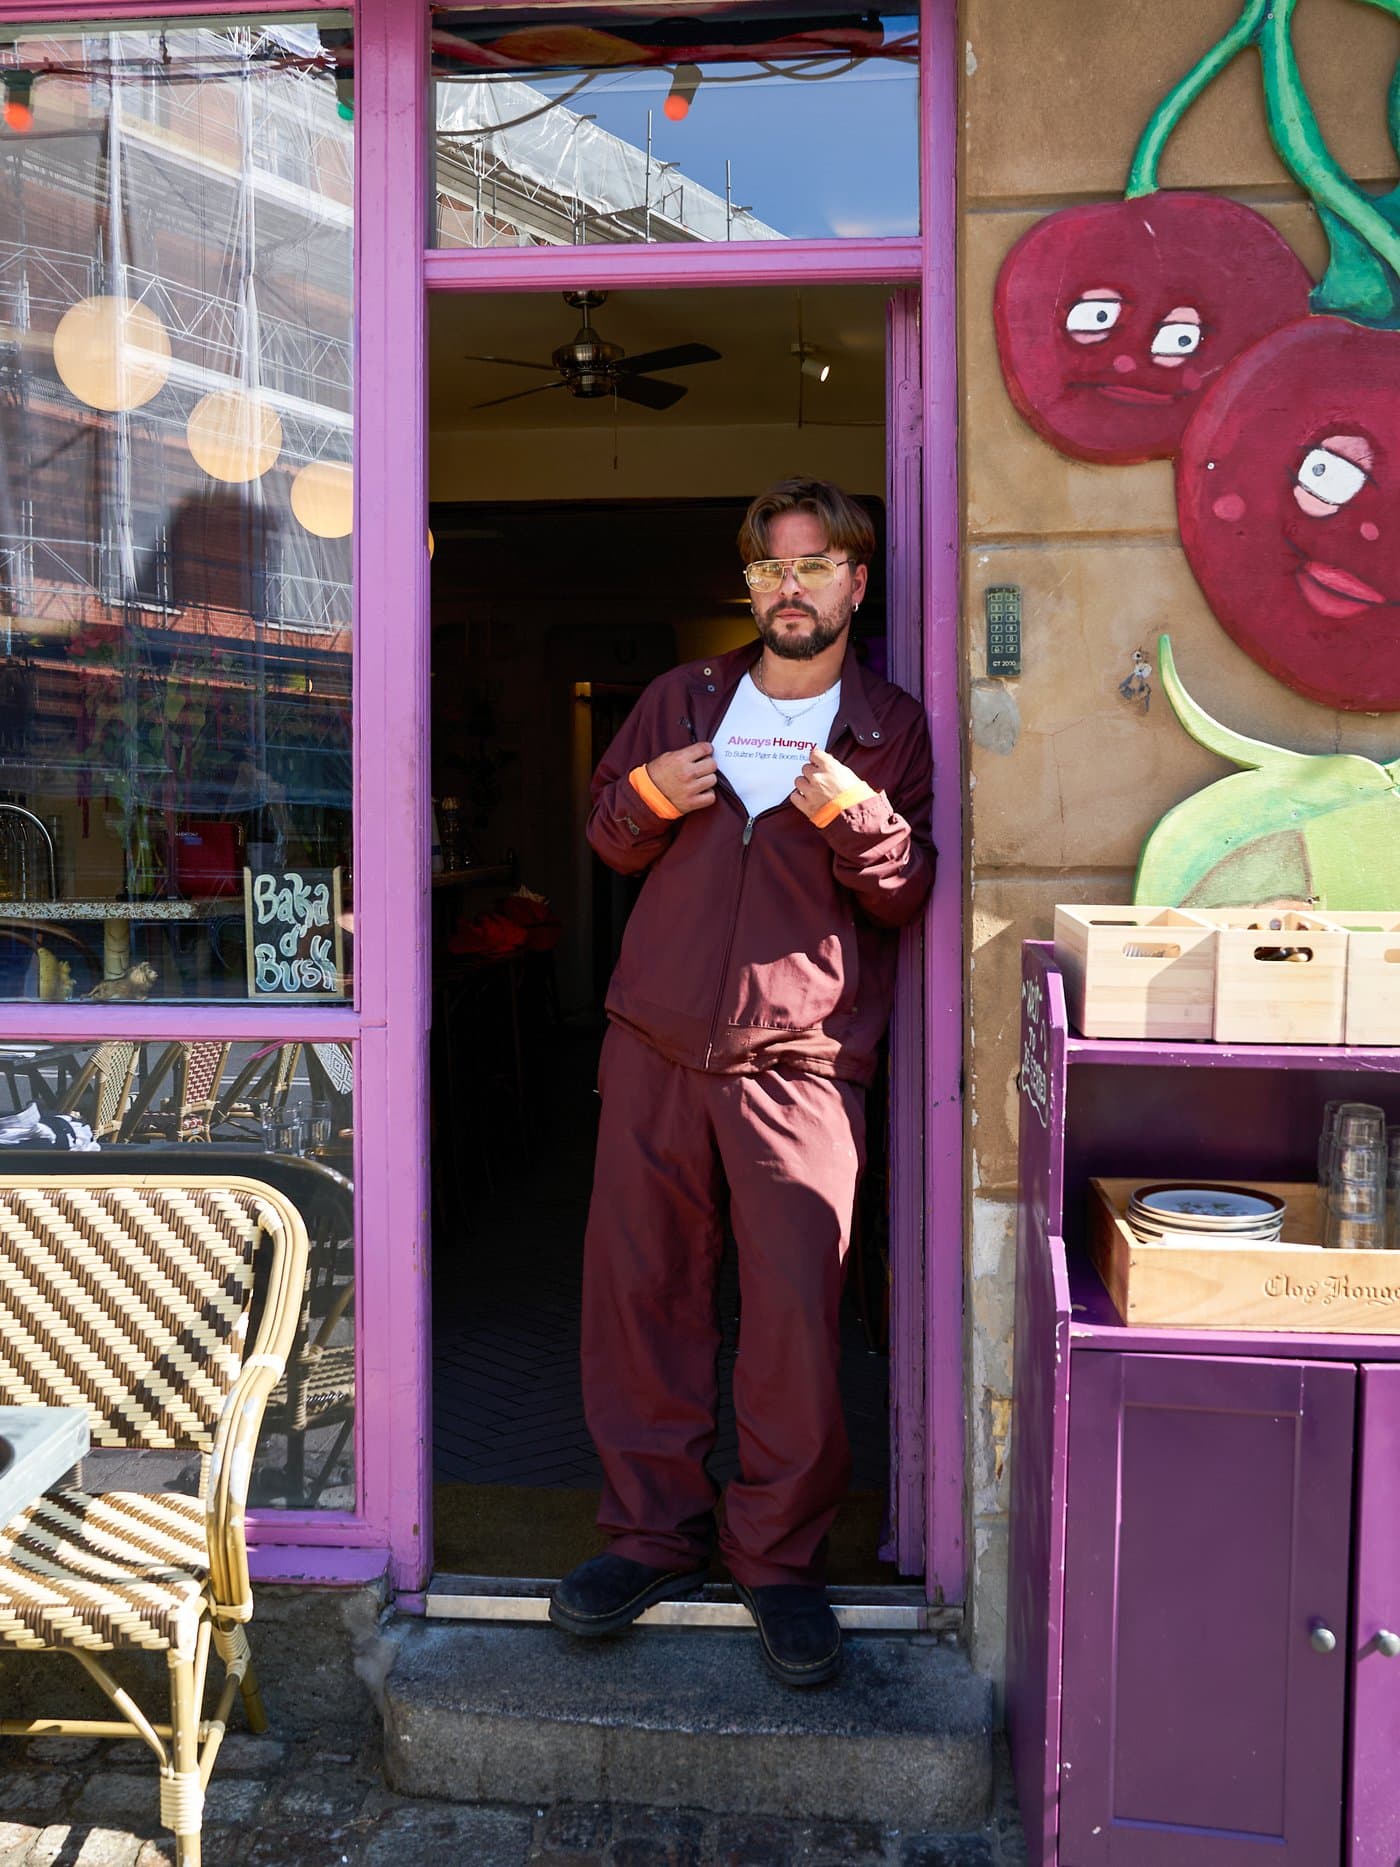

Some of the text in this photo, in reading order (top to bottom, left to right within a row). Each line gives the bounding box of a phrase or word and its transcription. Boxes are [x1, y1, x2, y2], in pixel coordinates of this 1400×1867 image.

[727, 736, 817, 751] Always Hungry
[254, 872, 330, 928] Baka
[1264, 1272, 1319, 1304] Clos
